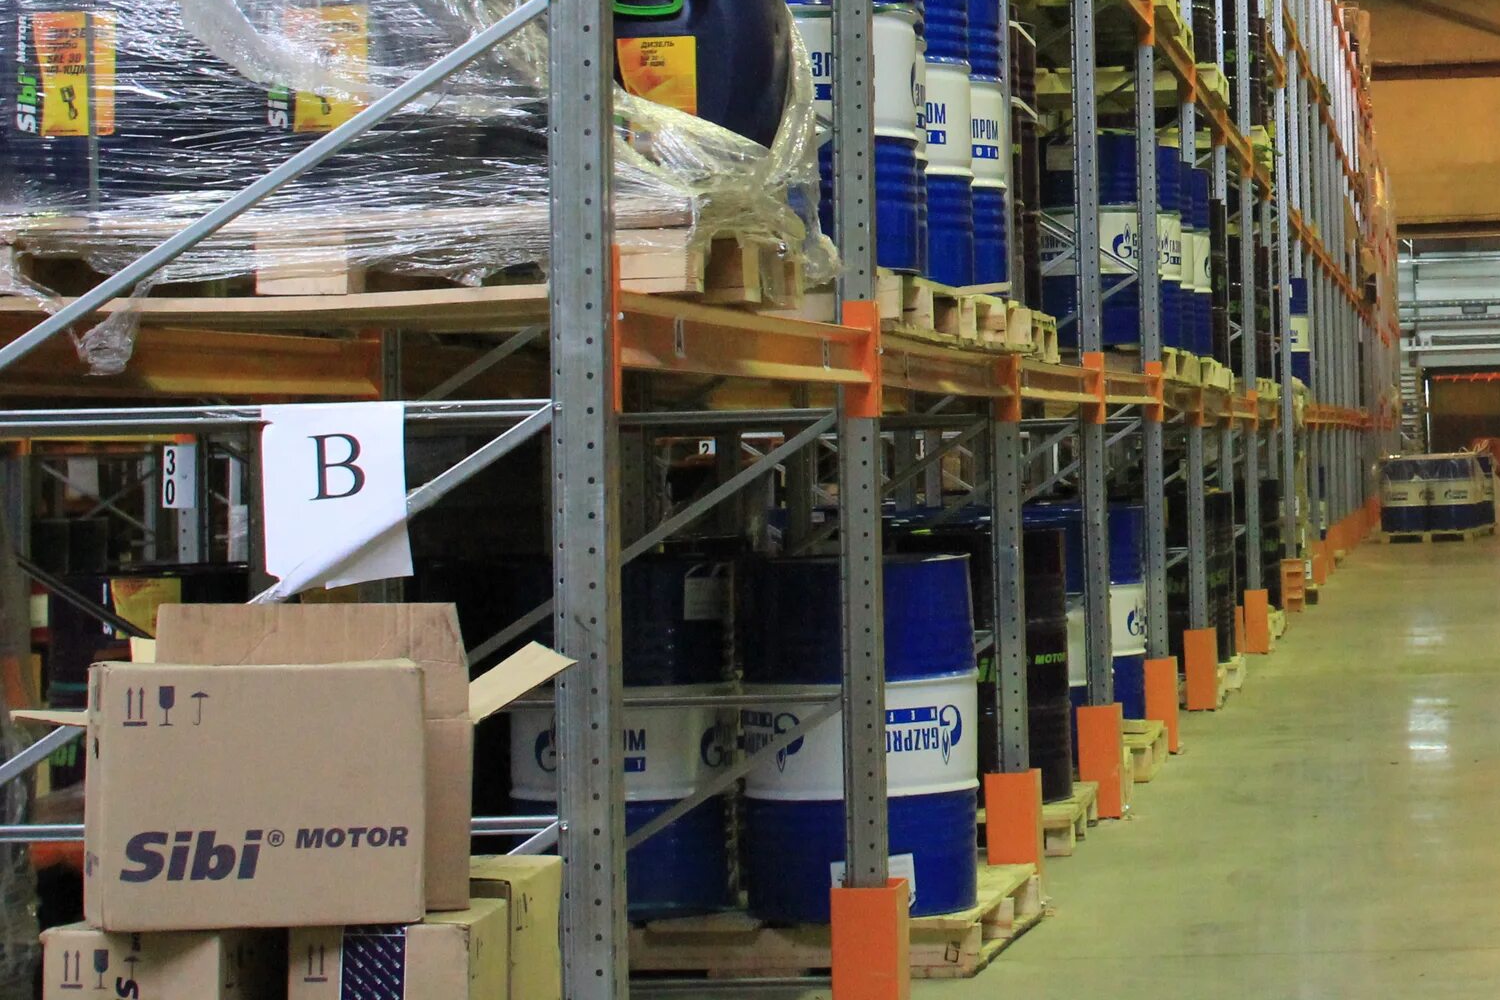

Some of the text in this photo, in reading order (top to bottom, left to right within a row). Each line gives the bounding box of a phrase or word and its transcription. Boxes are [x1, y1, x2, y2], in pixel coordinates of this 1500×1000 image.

[972, 119, 998, 141] ПРОМ
[308, 433, 366, 501] B
[885, 728, 940, 753] GAZPRO
[295, 826, 409, 849] MOTOR
